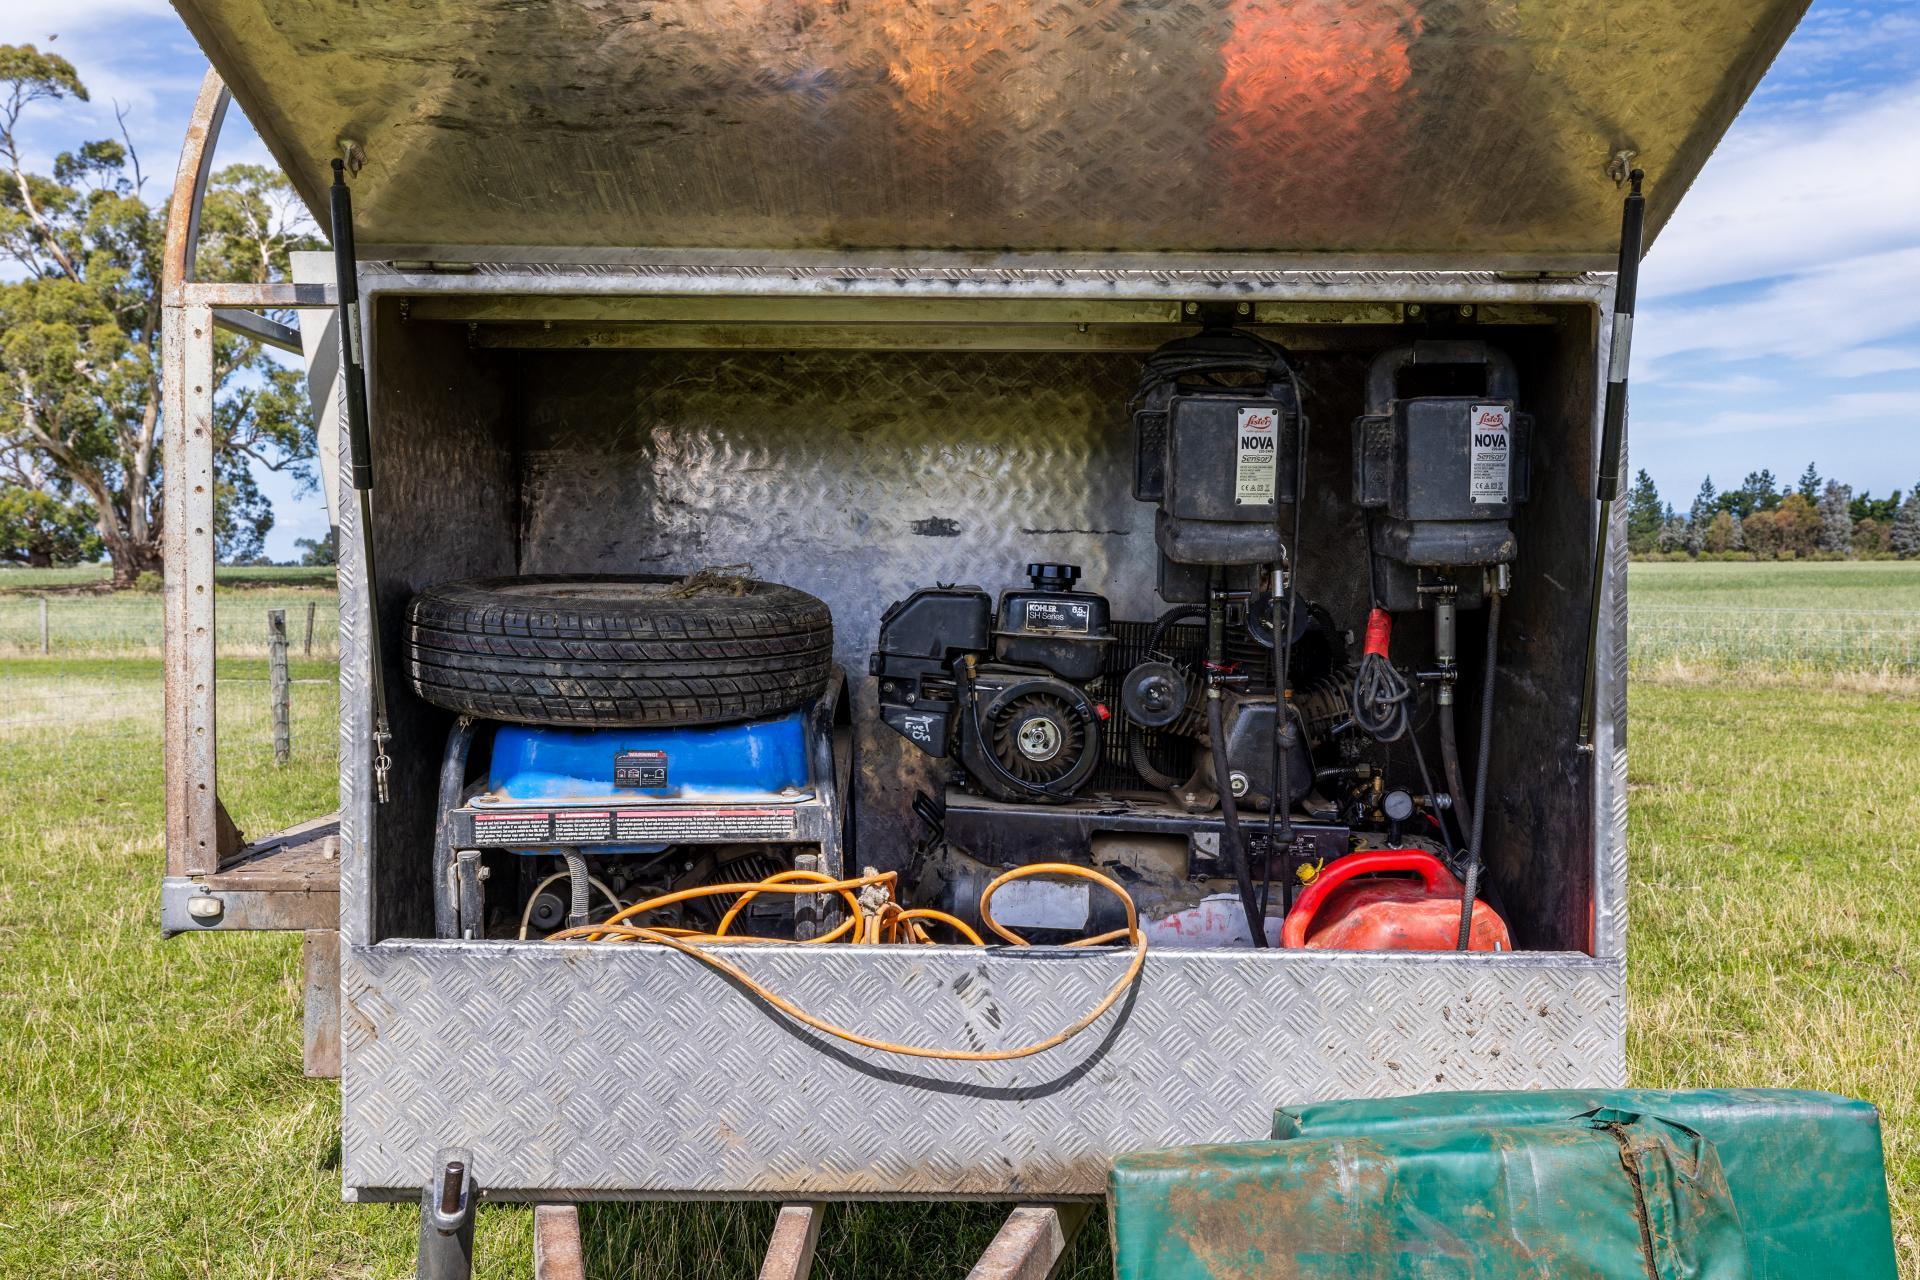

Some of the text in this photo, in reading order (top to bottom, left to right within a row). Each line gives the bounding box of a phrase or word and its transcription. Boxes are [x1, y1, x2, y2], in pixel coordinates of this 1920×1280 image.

[1243, 414, 1272, 429] Lister
[1476, 412, 1504, 427] Lister
[1241, 436, 1274, 449] NOVA
[1475, 434, 1507, 447] NOVA
[1242, 454, 1271, 463] Sensor
[1477, 453, 1505, 461] Sensor
[1030, 611, 1064, 621] SH Series
[905, 721, 929, 733] Fuel
[912, 731, 931, 742] On
